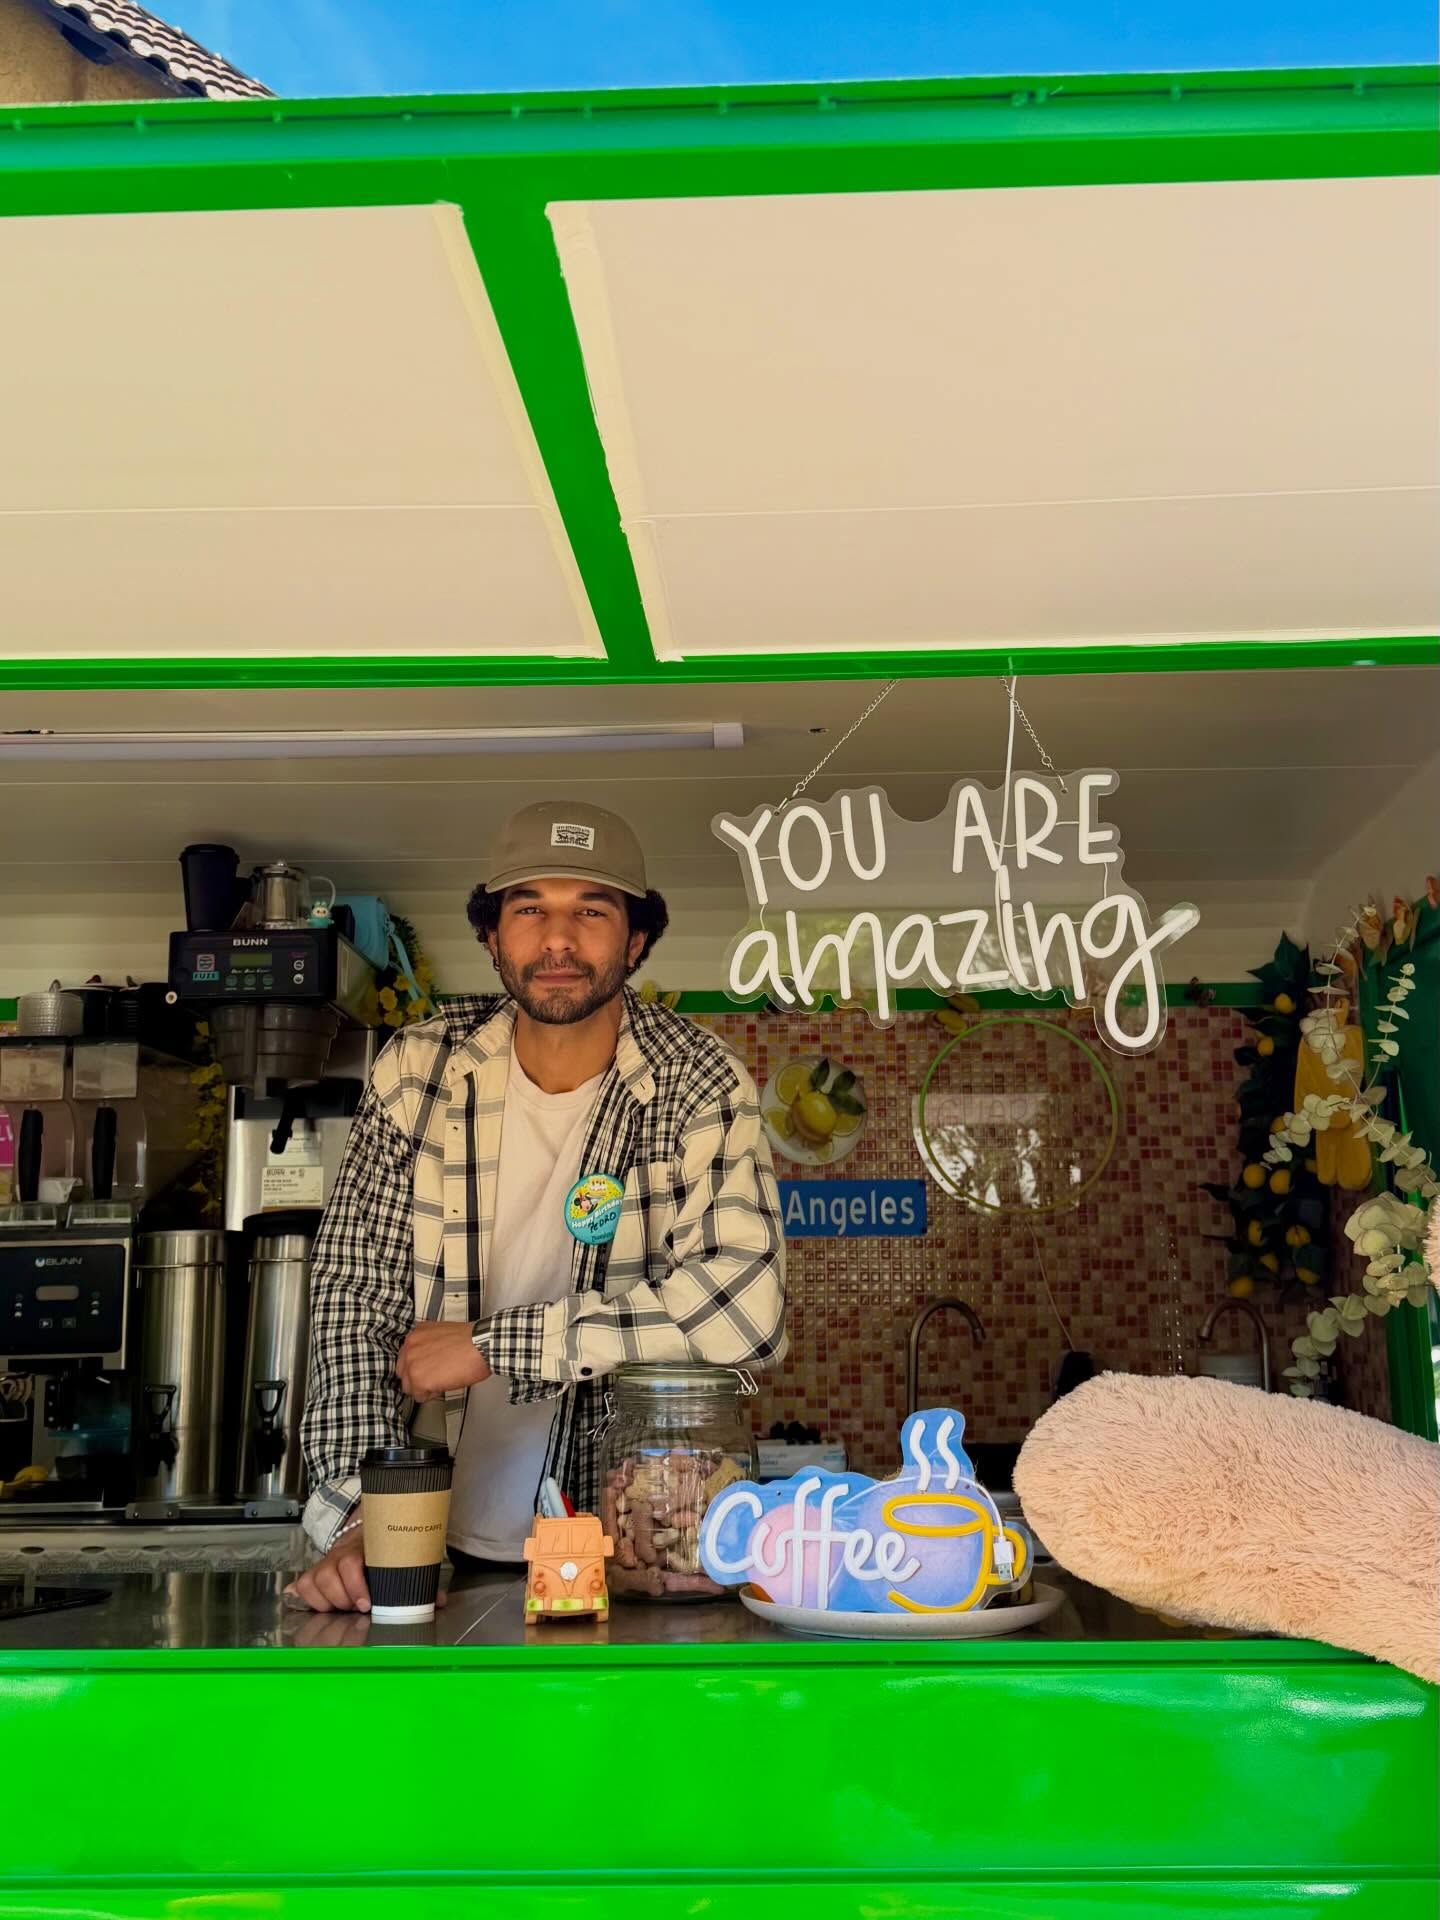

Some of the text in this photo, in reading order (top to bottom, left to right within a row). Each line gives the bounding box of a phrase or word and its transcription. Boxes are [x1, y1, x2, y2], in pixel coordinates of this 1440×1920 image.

[720, 774, 1118, 904] YOU ARE
[232, 938, 269, 946] BUNN
[729, 882, 1199, 1048] amazing
[785, 1189, 915, 1235] Angeles
[46, 1257, 82, 1265] BUNN
[387, 1524, 424, 1532] GUARAPO
[705, 1476, 921, 1610] Coffee
